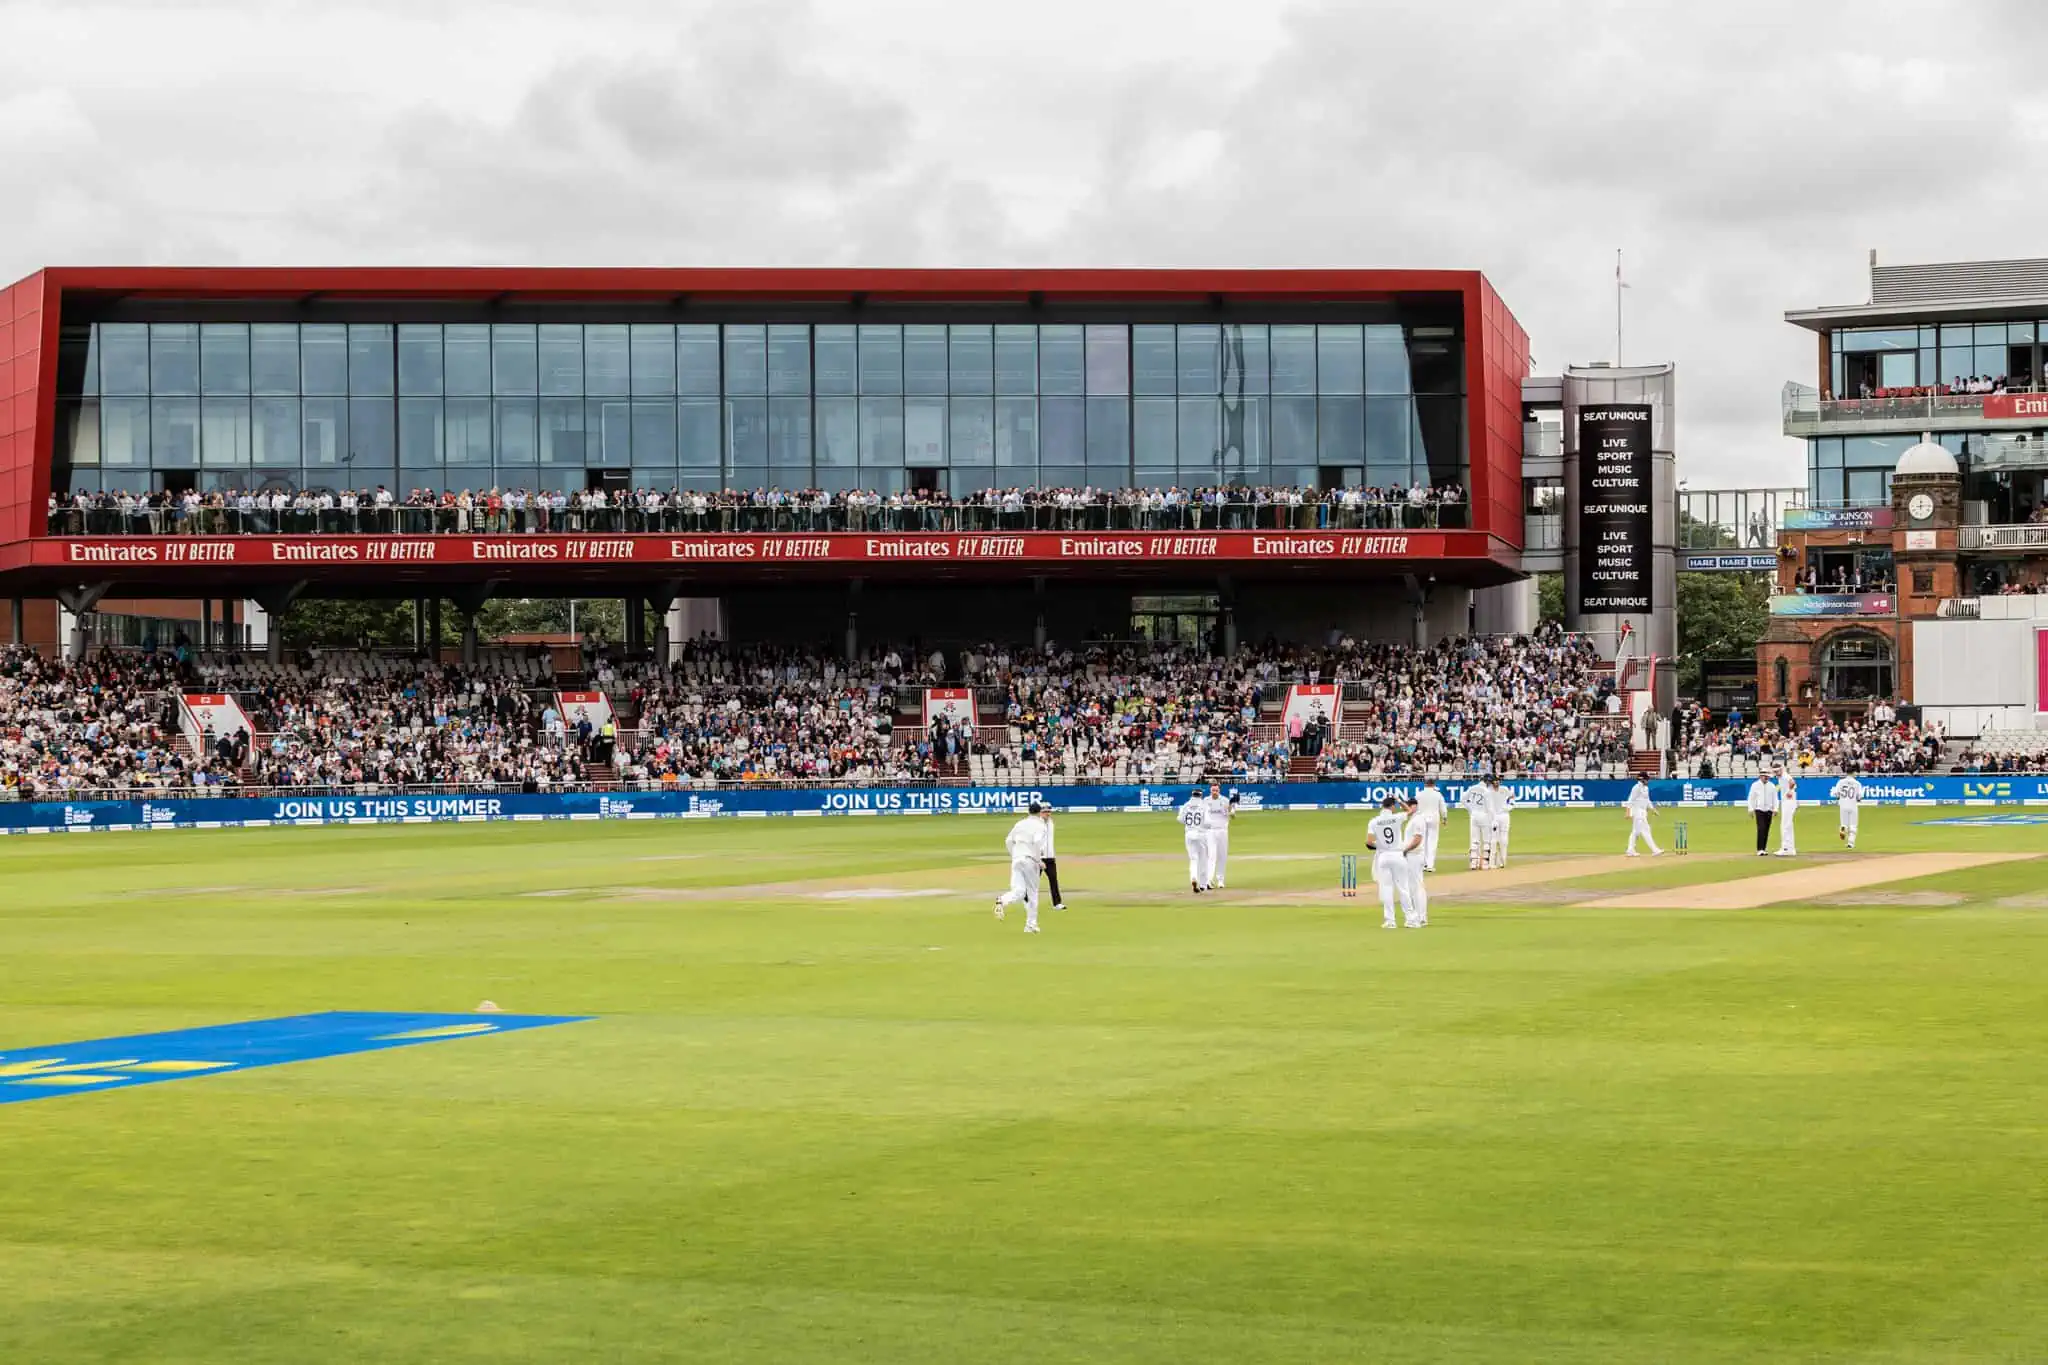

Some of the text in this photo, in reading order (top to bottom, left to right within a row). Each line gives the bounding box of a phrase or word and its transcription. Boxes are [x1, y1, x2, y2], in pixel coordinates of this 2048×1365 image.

[1584, 411, 1648, 421] SEAT UNIQUE
[1602, 439, 1628, 447] LIVE
[1597, 452, 1633, 460] SPORT
[1598, 465, 1632, 474] MUSIC
[1592, 479, 1639, 487] CULTURE
[1584, 504, 1648, 513] SEAT UNIQUE
[1824, 511, 1873, 520] DICKINSON
[1602, 532, 1628, 540] LIVE
[70, 543, 236, 561] Emirates FLY BETTER
[272, 542, 436, 560] Emirates FLY BETTER
[473, 541, 634, 558] Emirates FLY BETTER
[671, 540, 830, 557] Emirates FLY BETTER
[866, 539, 1025, 557] Emirates FLY BETTER
[1061, 538, 1217, 556] Emirates FLY BETTER
[1253, 537, 1408, 554] Emirates FLY BETTER
[1597, 545, 1633, 553] SPORT
[1598, 558, 1632, 567] MUSIC
[1690, 559, 1714, 567] HARE
[1592, 571, 1639, 580] CULTURE
[1584, 597, 1648, 606] SEAT UNIQUE
[1360, 787, 1409, 802] JOIN
[1503, 785, 1585, 800] UMMER
[1840, 785, 1855, 799] 50
[821, 791, 1043, 809] JOIN US THIS SUMMER
[274, 799, 502, 818] JOIN US THIS SUMMER
[1186, 812, 1201, 825] 66
[1383, 827, 1394, 844] 9
